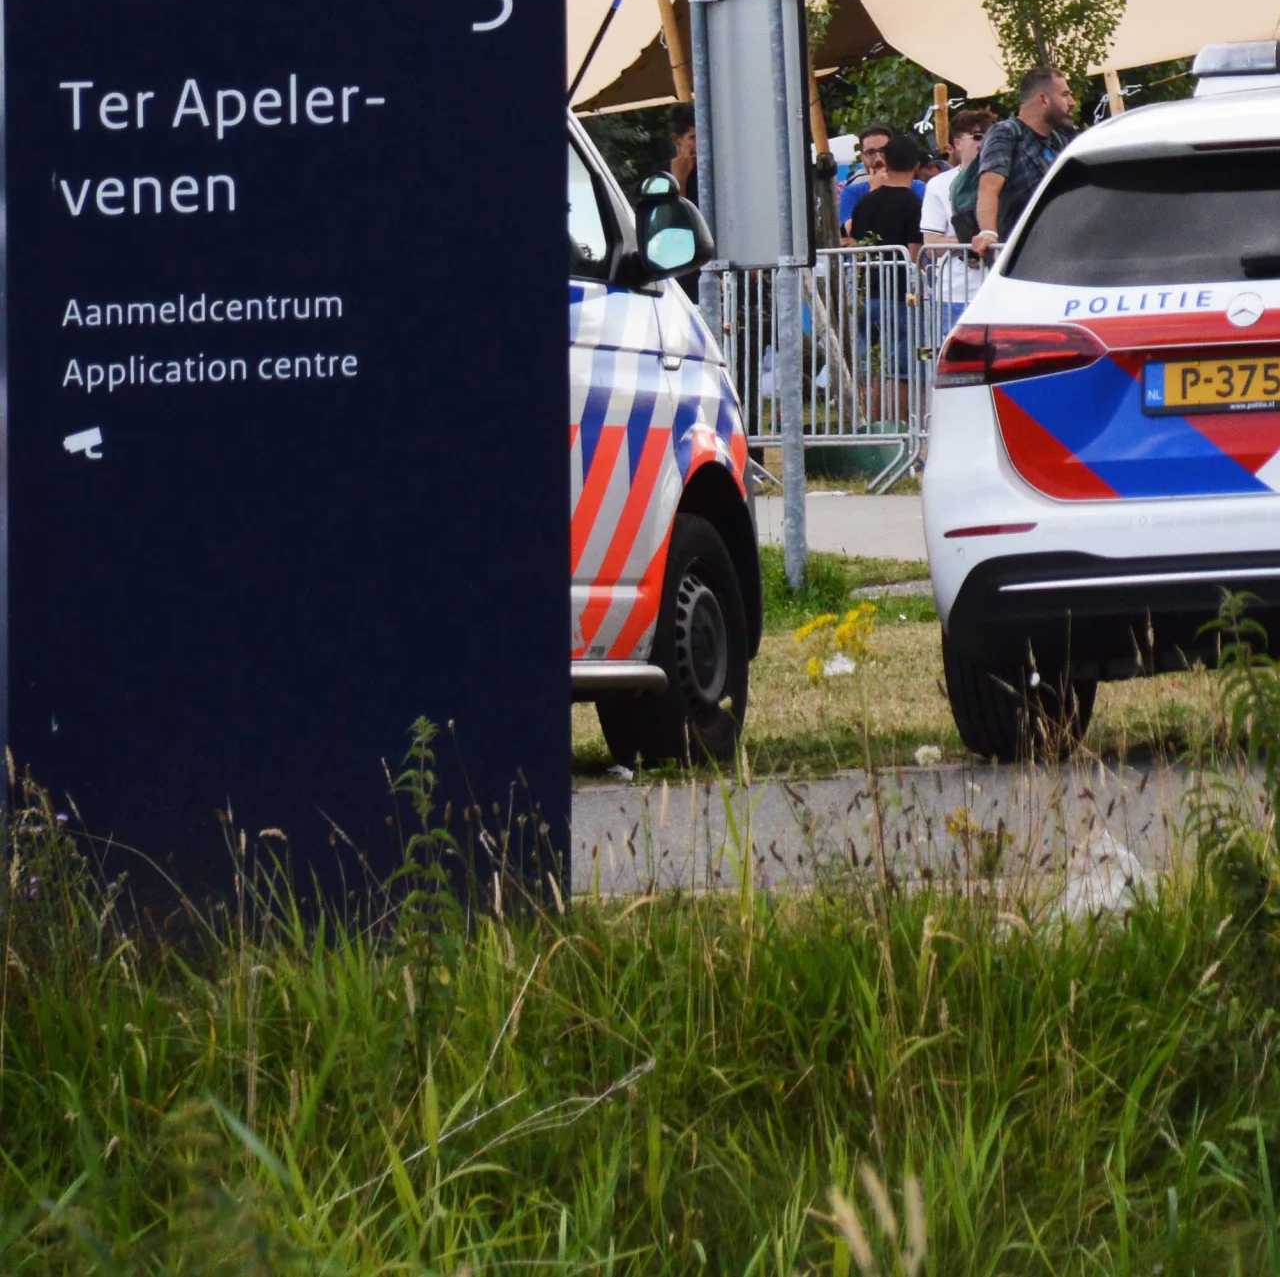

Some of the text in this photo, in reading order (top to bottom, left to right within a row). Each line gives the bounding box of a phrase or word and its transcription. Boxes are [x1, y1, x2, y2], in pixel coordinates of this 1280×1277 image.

[59, 73, 386, 140] Ter Apeler-
[59, 174, 236, 216] venen
[62, 293, 343, 327] Aanmeldcentrum
[1064, 289, 1213, 317] POLITIE
[62, 353, 358, 393] Application centre
[1147, 389, 1162, 401] NL
